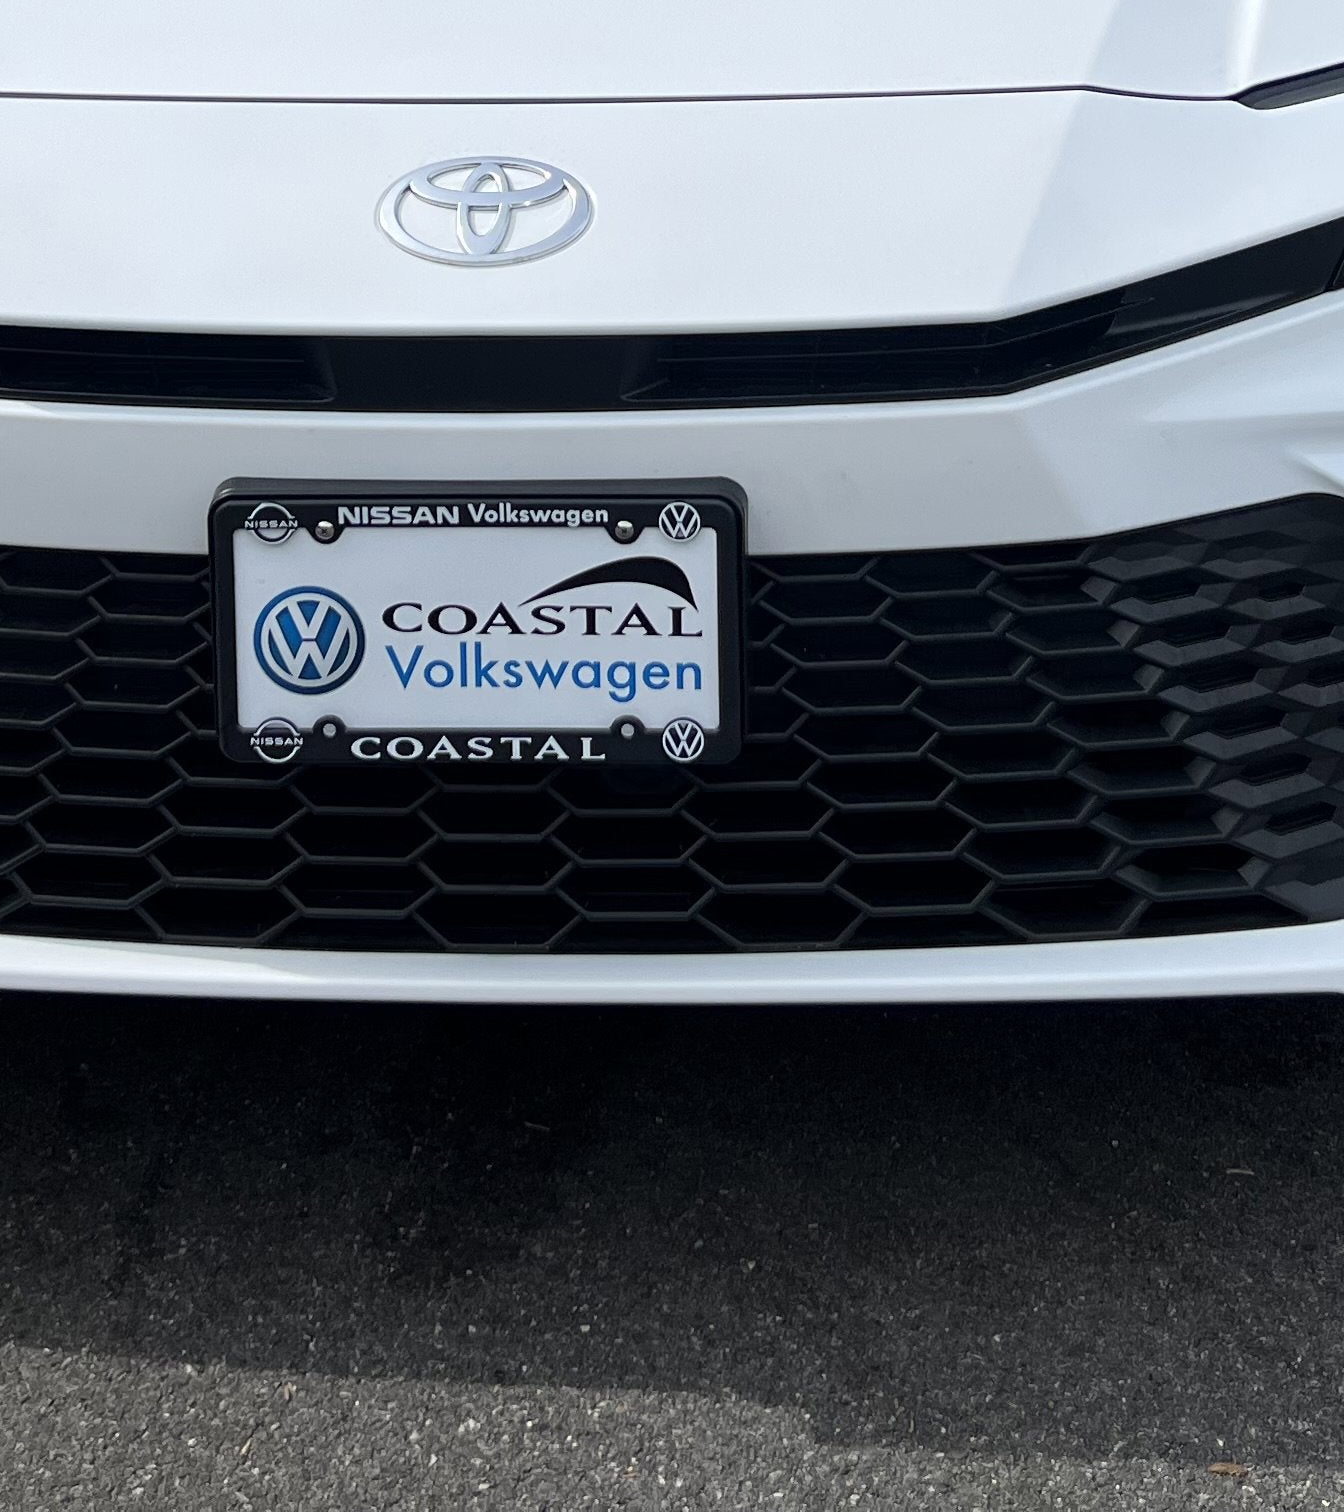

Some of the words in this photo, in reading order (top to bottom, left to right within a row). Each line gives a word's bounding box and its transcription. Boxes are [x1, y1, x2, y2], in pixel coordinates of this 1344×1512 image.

[338, 505, 460, 525] NISSAN
[468, 502, 609, 527] Volkswagen
[382, 601, 703, 637] COASTAL
[385, 641, 703, 703] Volkswagen
[351, 736, 606, 761] COASTAL
